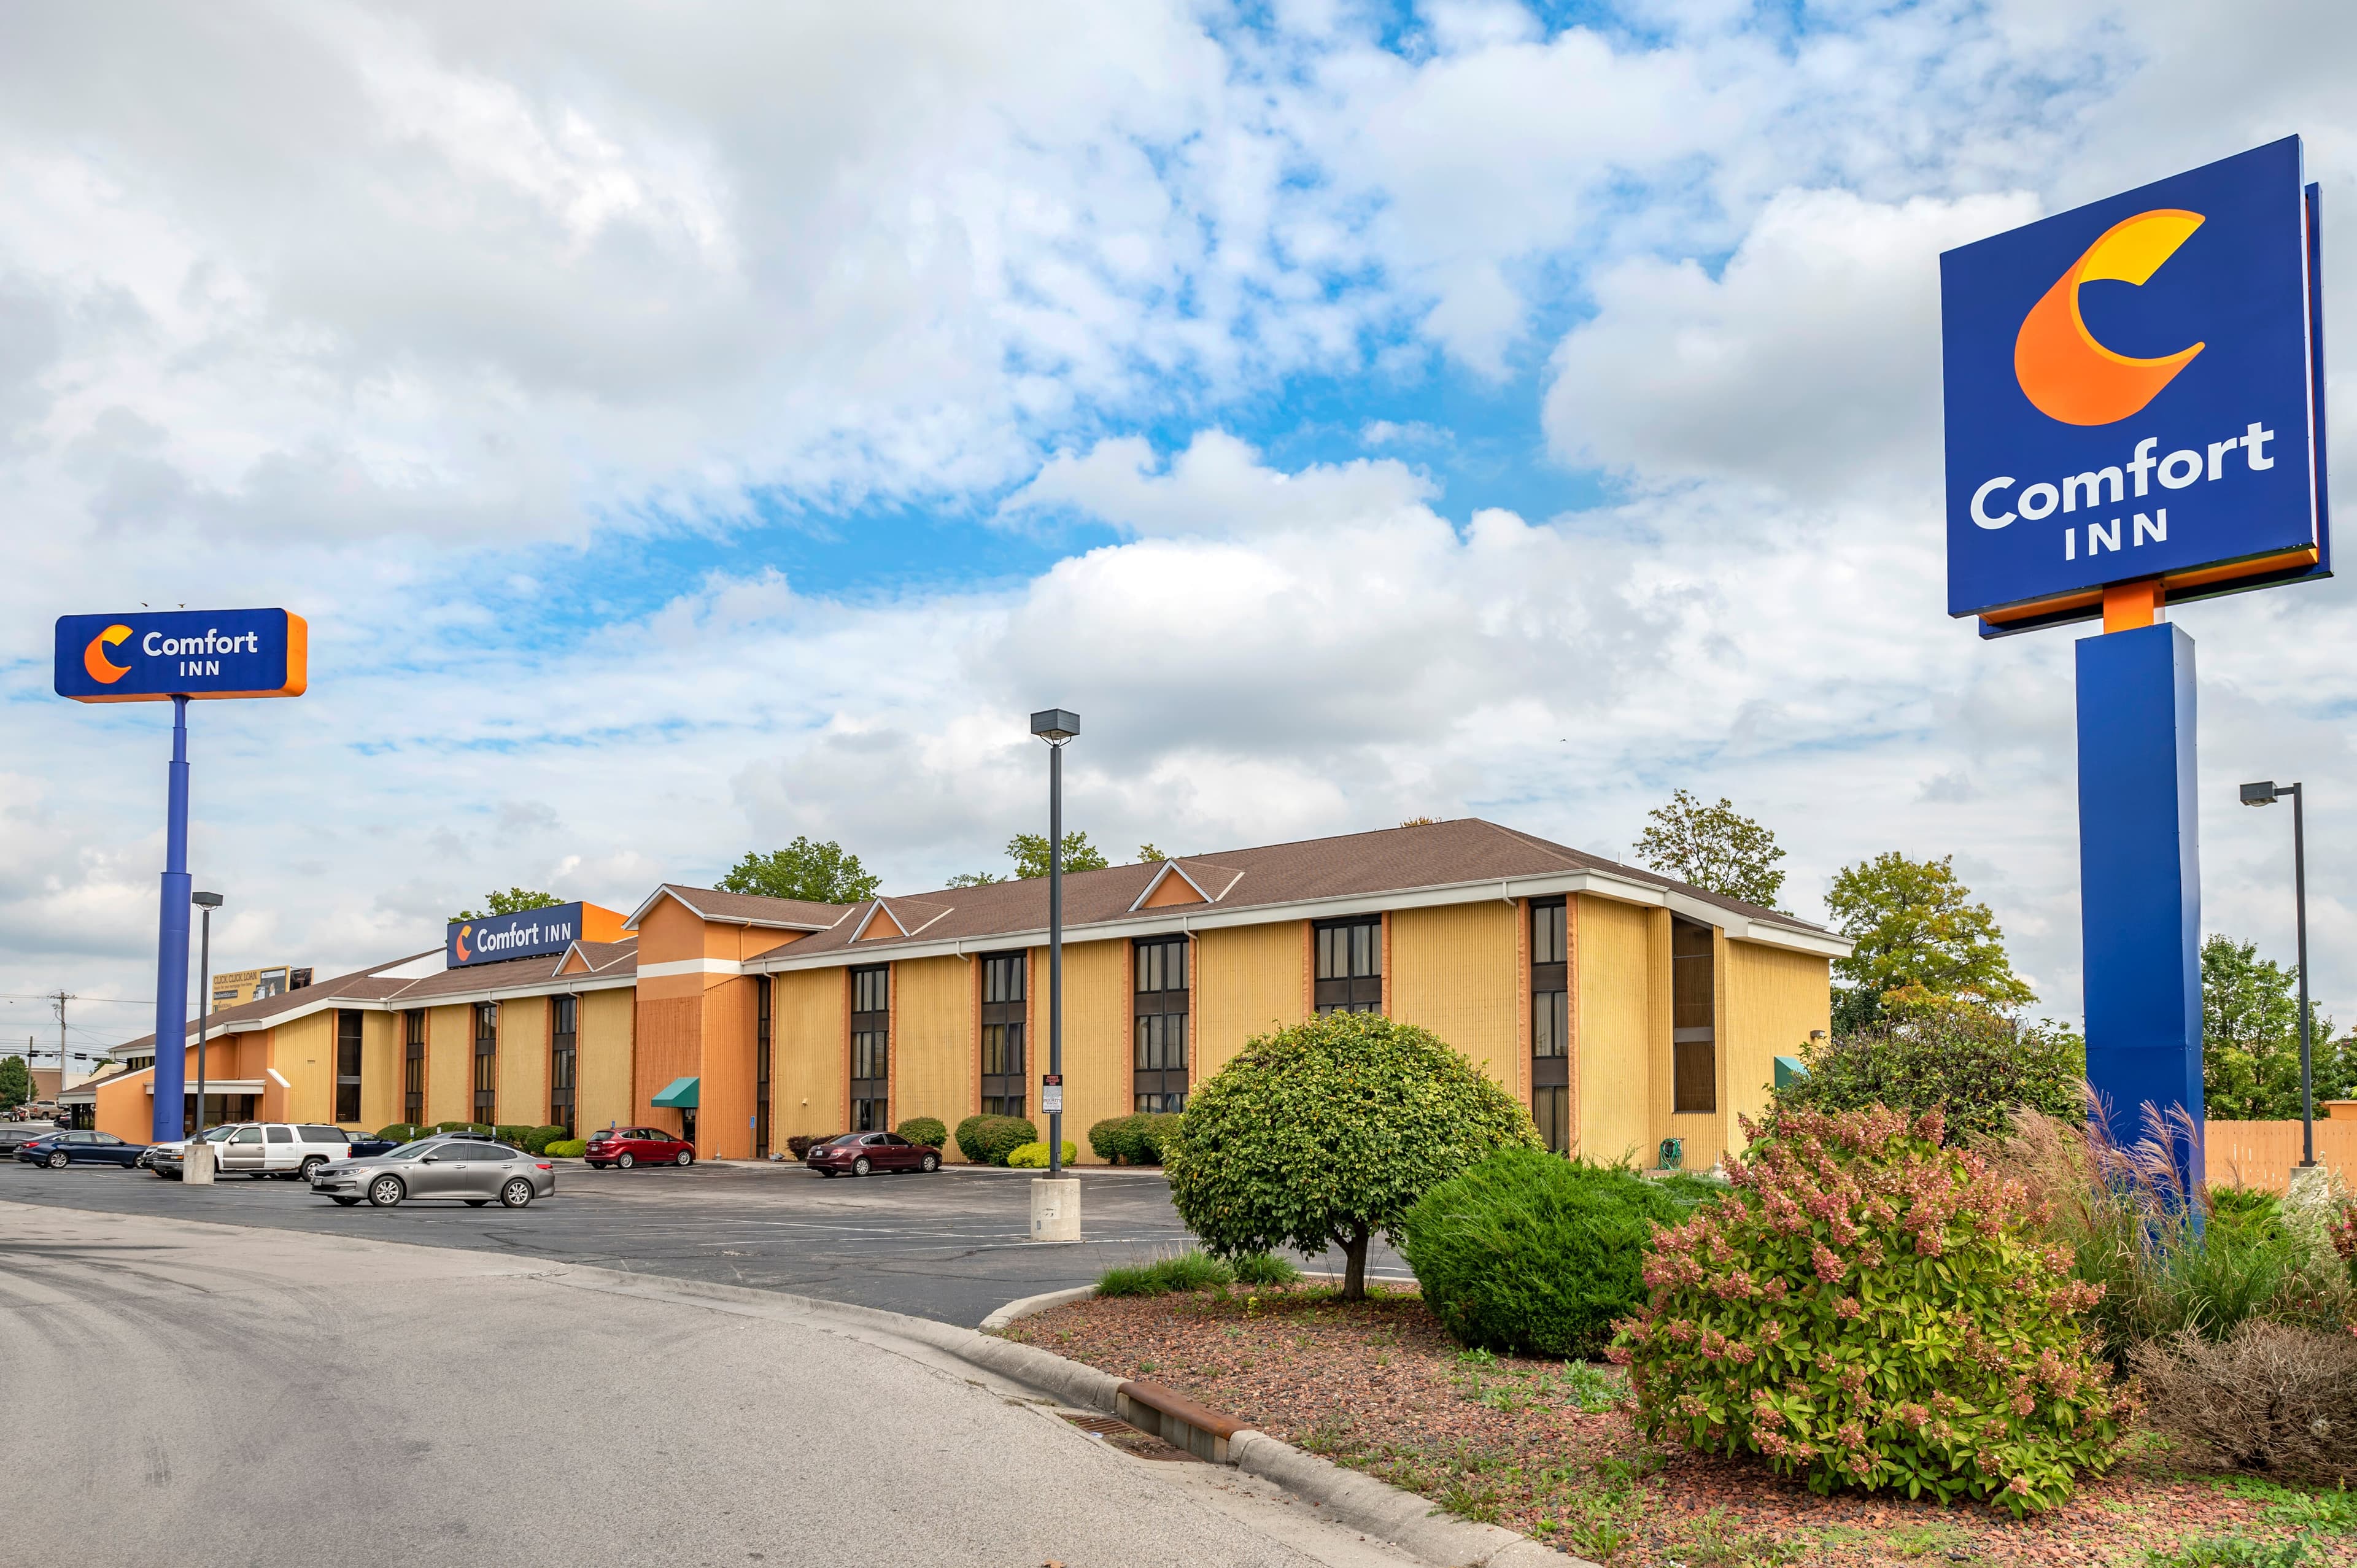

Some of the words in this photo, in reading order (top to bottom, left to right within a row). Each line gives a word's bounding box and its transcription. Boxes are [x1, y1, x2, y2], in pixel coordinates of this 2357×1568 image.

[1970, 422, 2274, 530] Comfort
[2065, 508, 2167, 561] INN
[142, 628, 258, 657] Comfort
[180, 660, 220, 677] INN
[477, 922, 539, 952] Comfort
[545, 922, 571, 943] INN
